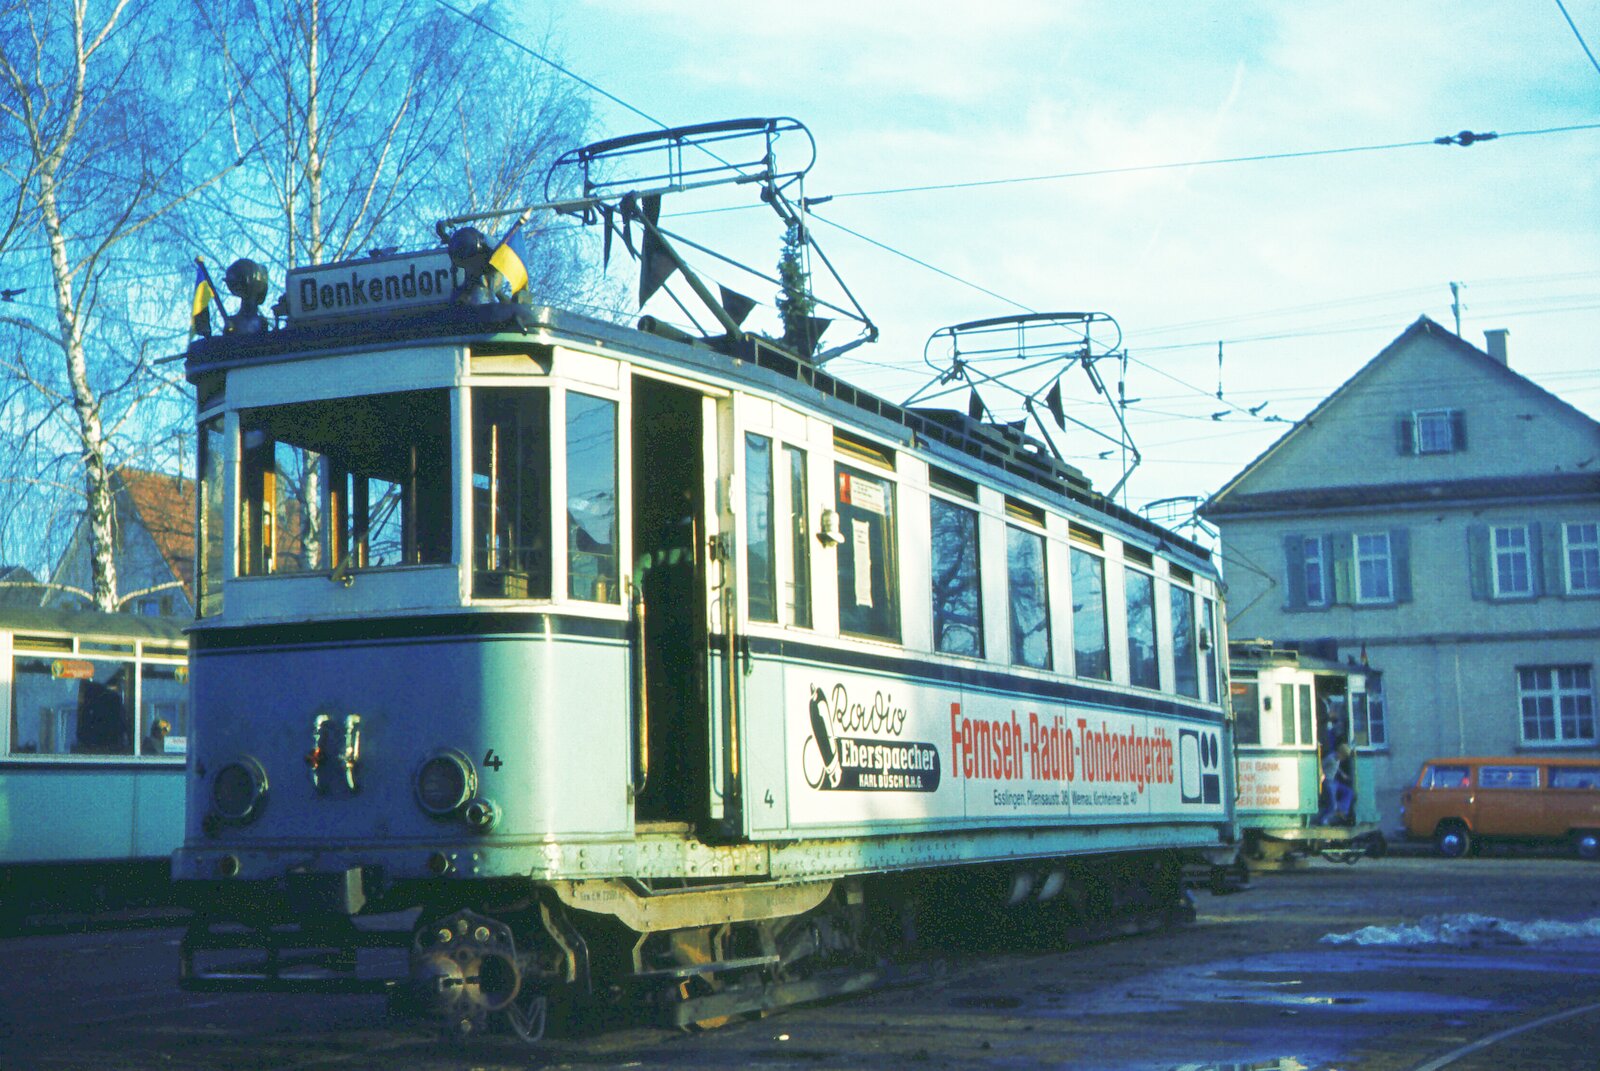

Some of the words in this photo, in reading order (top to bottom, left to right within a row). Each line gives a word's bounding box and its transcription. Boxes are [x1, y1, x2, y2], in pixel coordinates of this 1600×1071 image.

[483, 748, 503, 772] 4
[841, 739, 935, 775] Eberspaecher
[1254, 761, 1280, 772] BANK
[859, 773, 877, 788] KARL
[878, 774, 904, 789] BUSCH
[1255, 784, 1280, 794] BANK
[764, 788, 774, 808] 4
[1255, 795, 1280, 806] BANK
